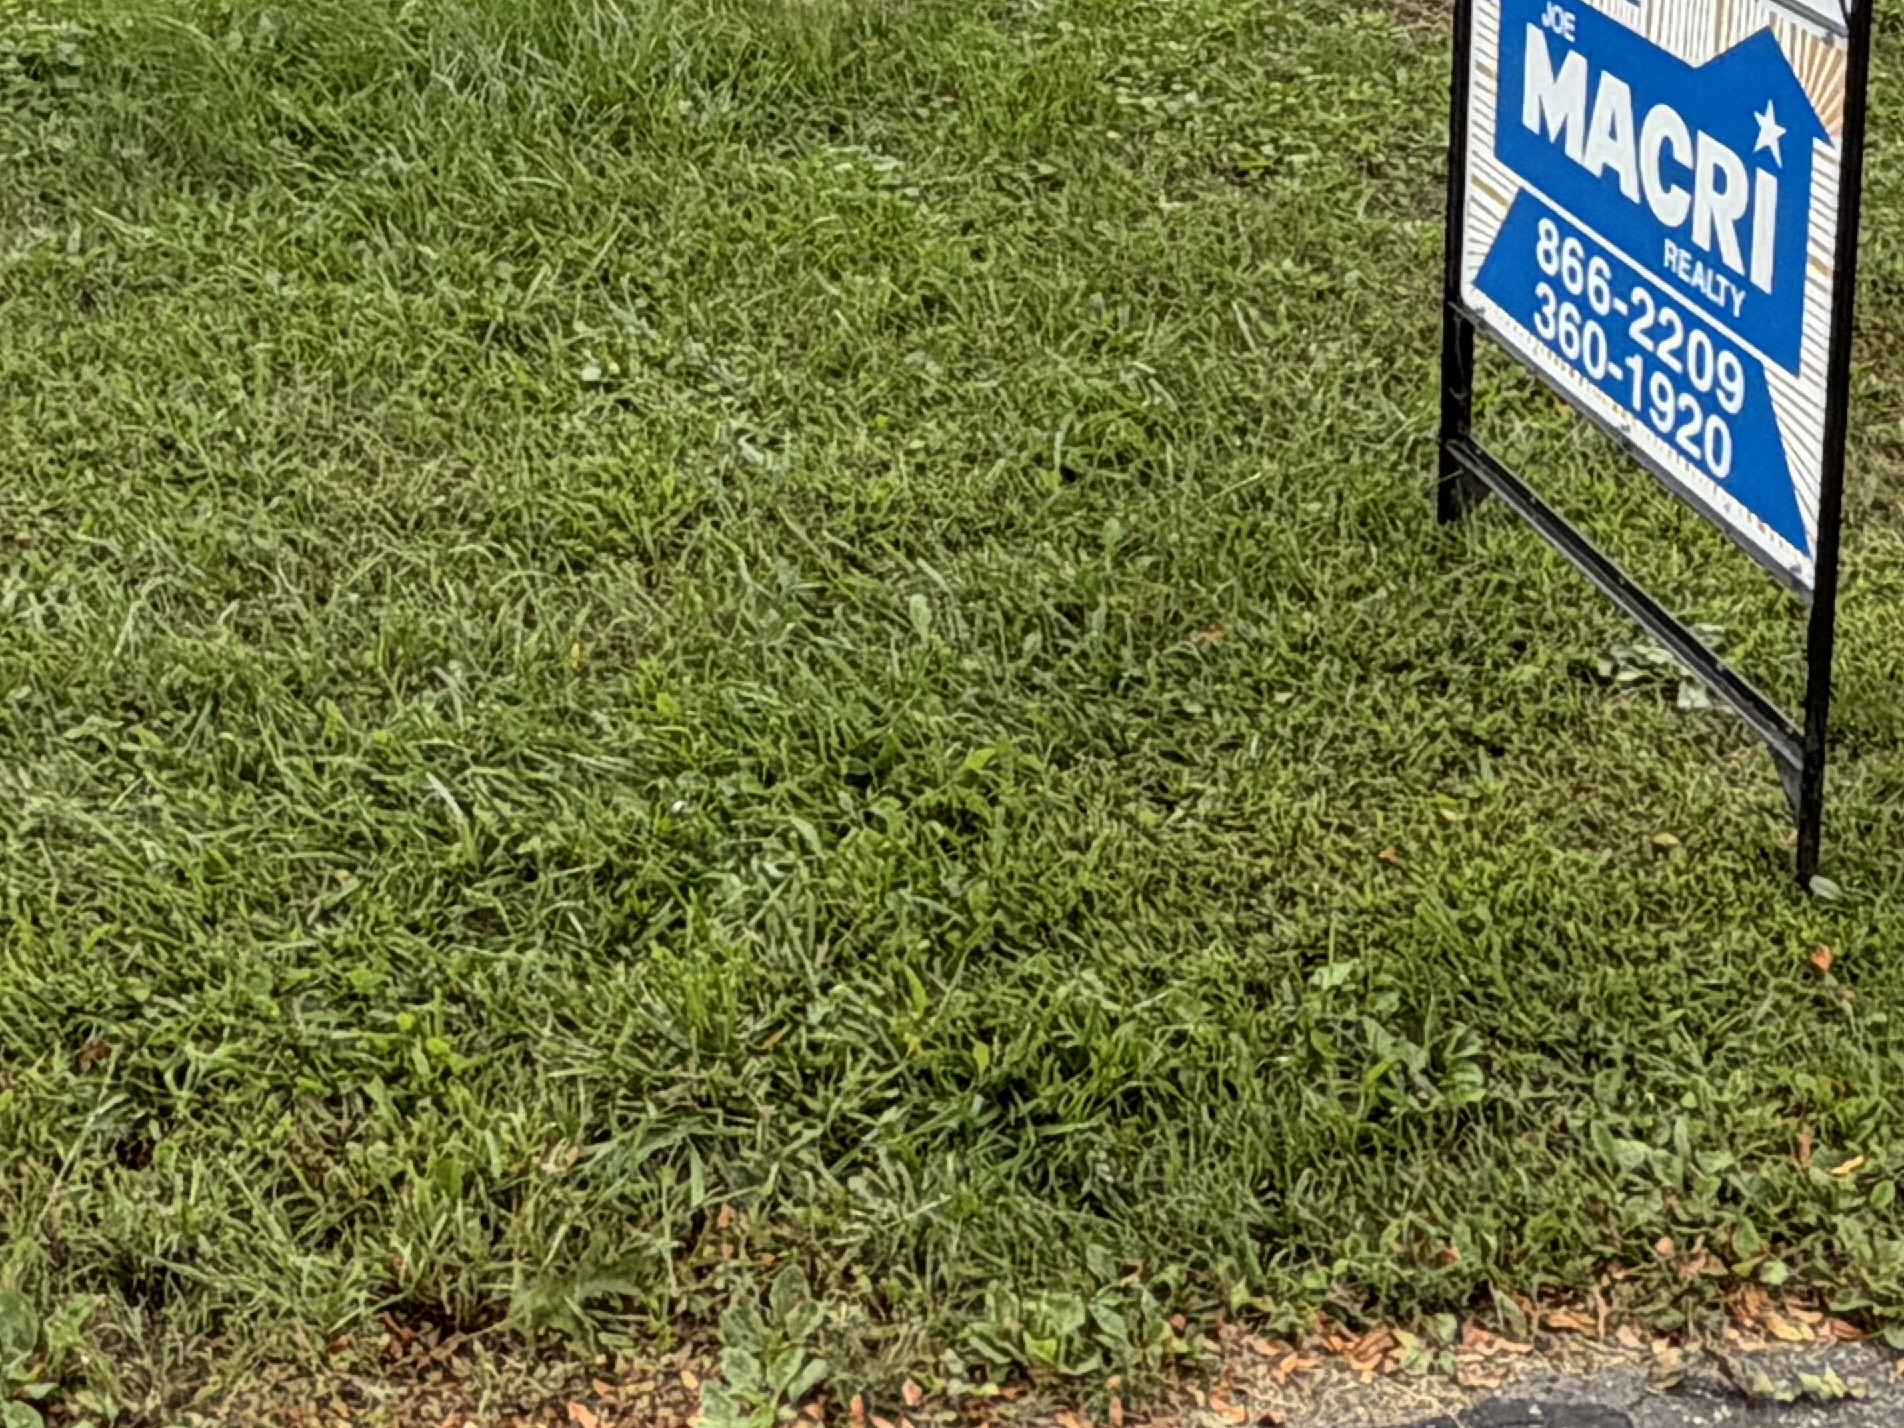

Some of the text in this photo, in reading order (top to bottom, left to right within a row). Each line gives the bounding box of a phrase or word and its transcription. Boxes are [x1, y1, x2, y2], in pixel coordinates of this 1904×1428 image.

[1541, 0, 1576, 43] JOE
[1535, 217, 1744, 414] 866-2209
[1662, 238, 1746, 318] REALTY
[1533, 281, 1733, 479] 360-1920
